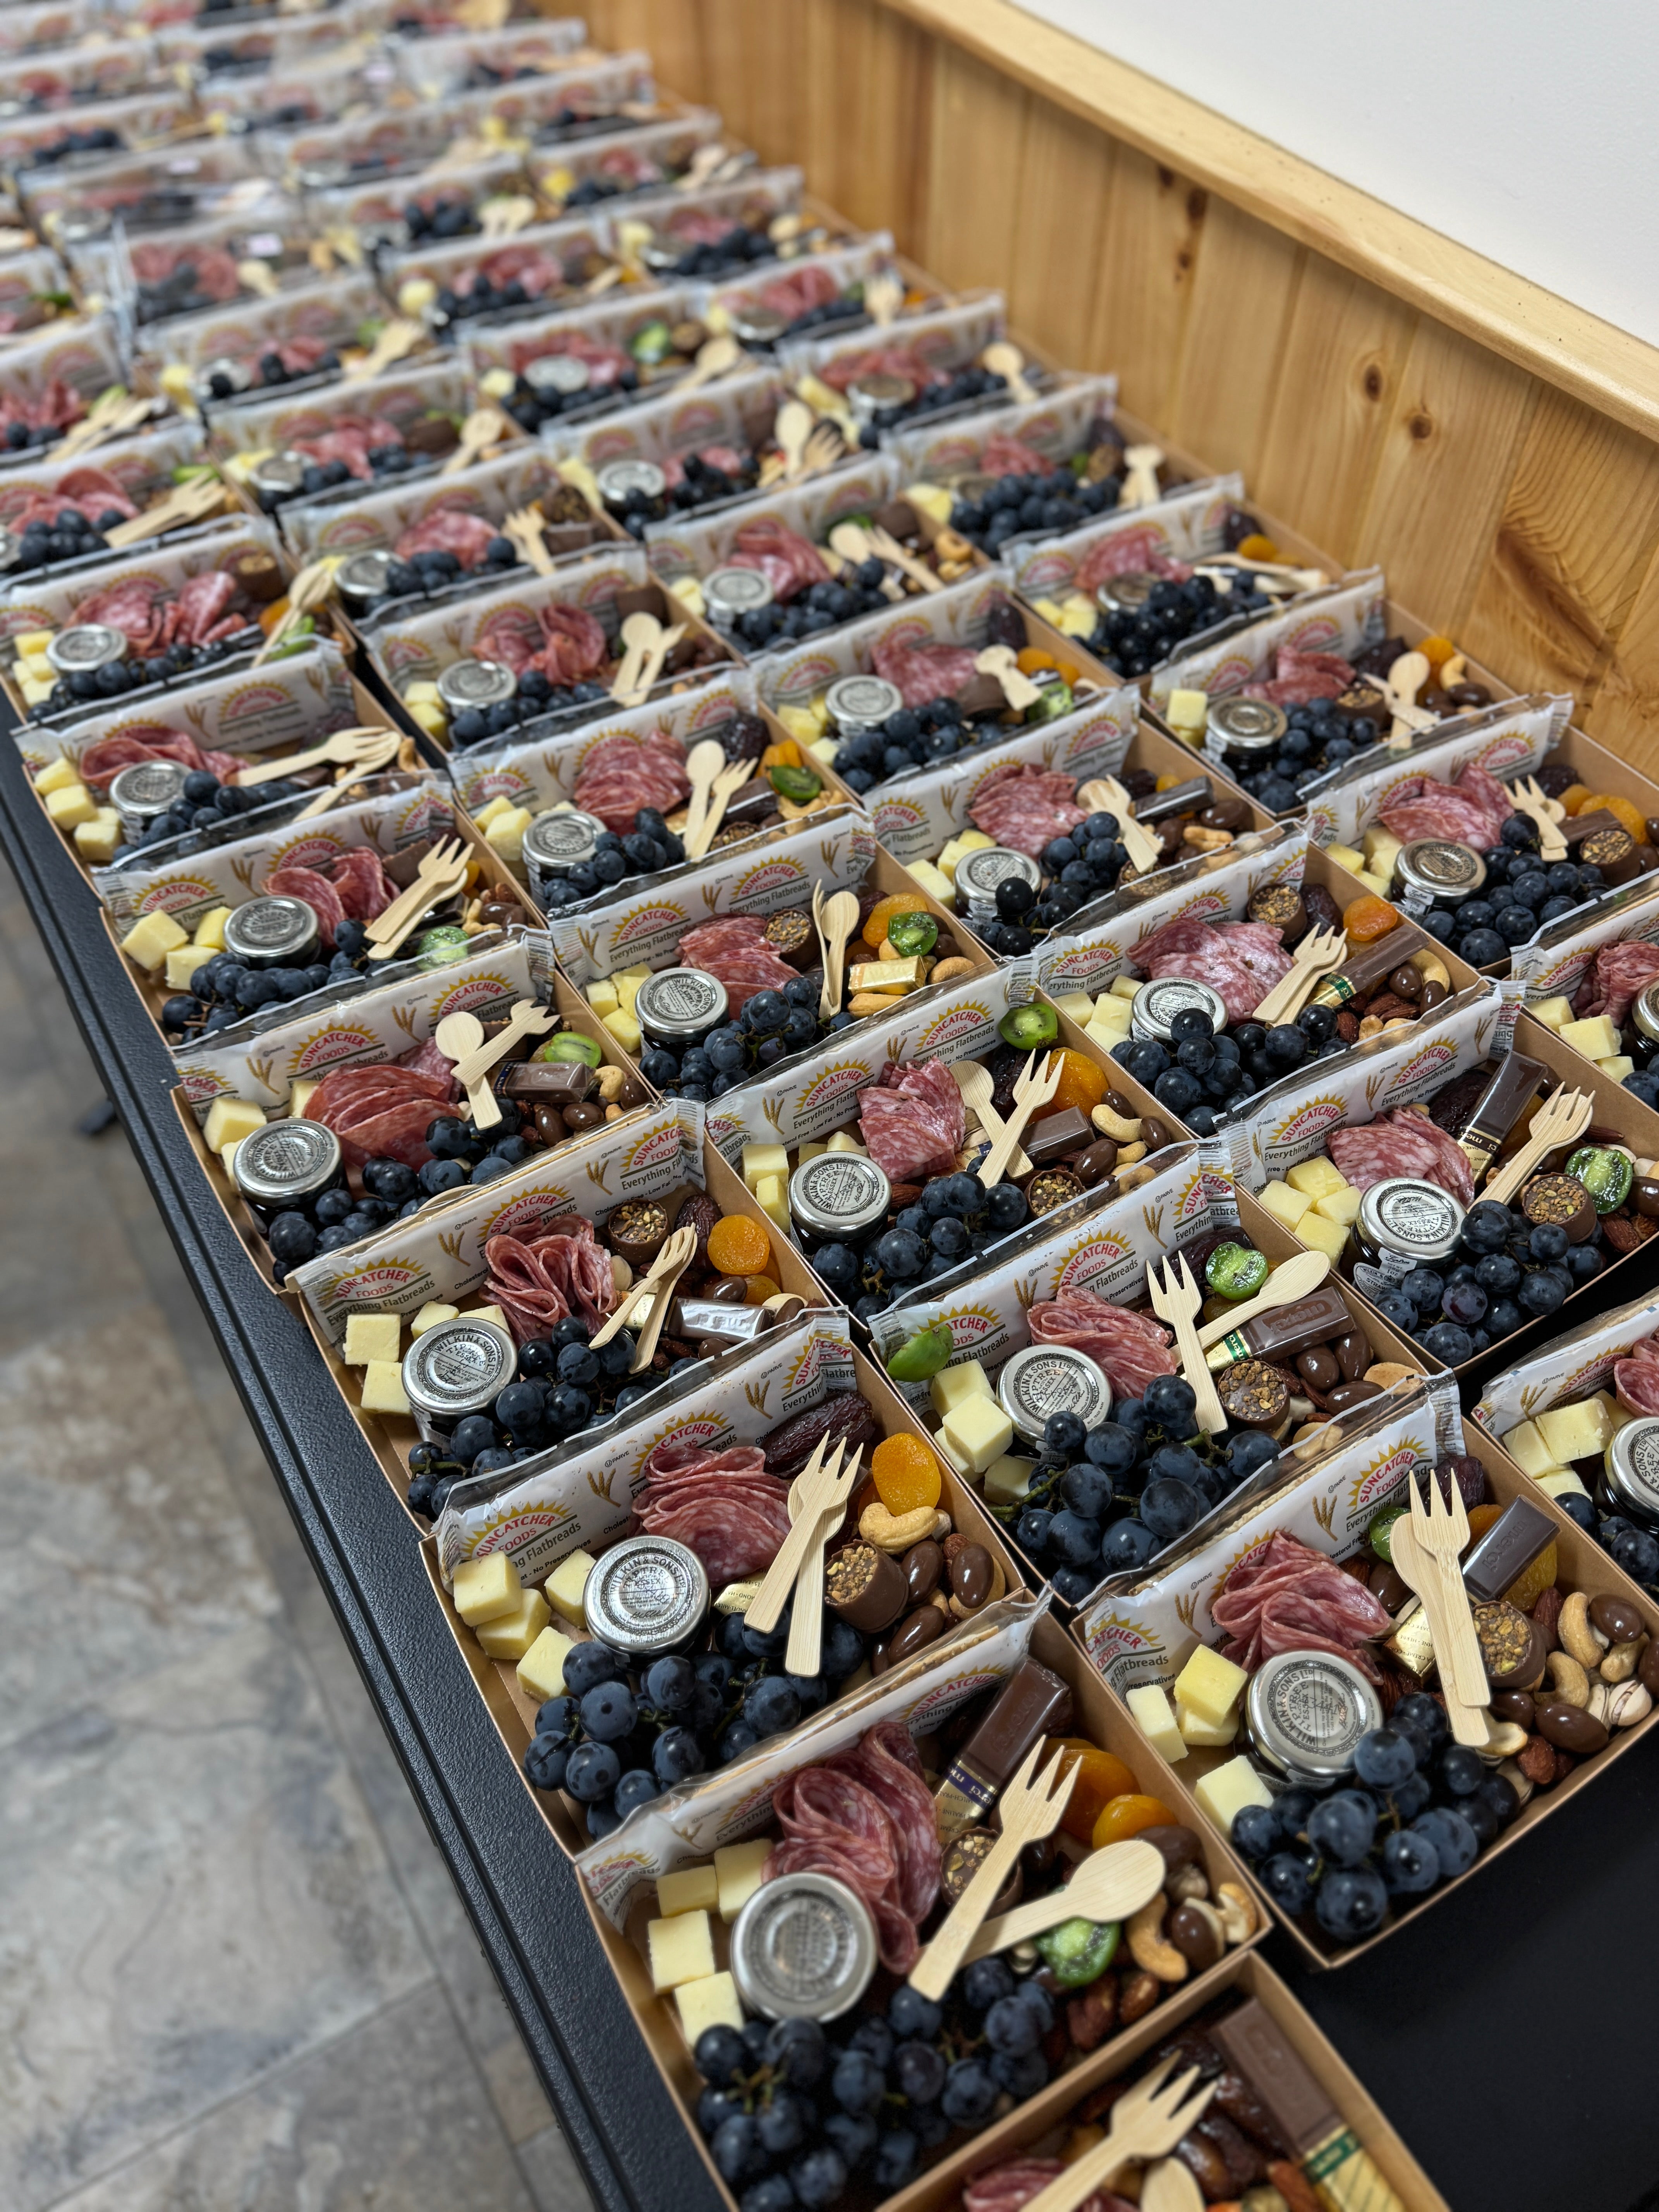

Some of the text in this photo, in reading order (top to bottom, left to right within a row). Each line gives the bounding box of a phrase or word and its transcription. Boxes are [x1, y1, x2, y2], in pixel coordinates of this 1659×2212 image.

[741, 865, 798, 895] SUNCATCHER
[755, 878, 783, 891] FOODS
[771, 882, 811, 902] Flatbreads
[621, 910, 678, 941] SUNCATCHER
[635, 922, 663, 937] FOODS
[610, 941, 651, 963] Everything
[1056, 949, 1112, 975] SUNCATCHER
[1049, 981, 1085, 990] erything
[1087, 962, 1121, 986] Flatbreads
[1072, 962, 1099, 975] FOODS
[441, 982, 501, 1016] SUNCATCHER
[458, 994, 488, 1012] FOODS
[674, 978, 704, 990] WILKIN
[700, 994, 711, 1011] SONS
[926, 1011, 983, 1046] SUNCATCHER
[941, 1024, 968, 1041] FOODS
[301, 1032, 366, 1068] SUNCATCHER
[316, 1045, 350, 1063] FOODS
[919, 1025, 994, 1066] verything Flatbreads
[963, 1039, 996, 1058] Preservatives
[1398, 1048, 1452, 1084] SUNCATCHER
[1412, 1062, 1437, 1080] FOODS
[807, 1071, 861, 1107] SUNCATCHER
[822, 1083, 848, 1102] FOODS
[1382, 1084, 1423, 1106] Everything
[1422, 1061, 1455, 1087] Flatbreads
[793, 1103, 834, 1130] Everything
[798, 1130, 810, 1140] Free
[813, 1123, 823, 1132] Low
[824, 1117, 833, 1125] Fat
[1281, 1106, 1339, 1142] SUNCATCHER
[1298, 1120, 1325, 1138] FOODS
[255, 1143, 268, 1162] SONS
[720, 1135, 751, 1158] atbreads
[1265, 1142, 1309, 1161] Everything
[1310, 1119, 1346, 1146] Flatbreads
[621, 1166, 671, 1191] Everything
[814, 1165, 835, 1180] SONS
[648, 1187, 661, 1195] Low
[810, 1185, 832, 1210] WILKIN
[1161, 1188, 1174, 1200] PARVE
[491, 1195, 556, 1234] SUNCATCHER
[508, 1207, 541, 1227] FOODS
[1400, 1217, 1439, 1233] TIPTREE
[1433, 1213, 1449, 1239] WILKIN
[1175, 1216, 1212, 1242] Everythin
[1396, 1227, 1422, 1240] SONS
[1034, 1262, 1049, 1272] PARVE
[1062, 1244, 1120, 1286] SUNCATCHER
[1077, 1259, 1106, 1281] FOODS
[1096, 1260, 1138, 1292] Flatbreads
[335, 1269, 410, 1298] SUNCATCHER
[356, 1283, 394, 1298] FOODS
[454, 1267, 488, 1290] Cholesterol
[1108, 1276, 1144, 1299] Preservatives
[383, 1279, 435, 1307] Flatbreads
[945, 1317, 988, 1334] ATCHER
[434, 1335, 474, 1352] WILKIN
[481, 1340, 496, 1362] SONS
[962, 1333, 1009, 1361] Flatbreads
[767, 1363, 783, 1375] PARVE
[984, 1350, 1018, 1373] reservatives
[783, 1381, 823, 1412] Everythin
[1022, 1379, 1040, 1413] WILKIN
[1031, 1362, 1057, 1374] SONS
[1040, 1377, 1056, 1396] ESSEX
[612, 1450, 629, 1463] PARVE
[644, 1424, 716, 1470] NCATCHER
[1640, 1439, 1649, 1452] LTD
[1637, 1451, 1650, 1477] SONS
[1333, 1475, 1346, 1490] PARVE
[1360, 1451, 1415, 1503] SUNCATCHER
[1376, 1468, 1404, 1496] FOODS
[603, 1515, 631, 1534] Cholest
[1346, 1497, 1392, 1533] Everything
[477, 1515, 555, 1558] SUNCATCHER
[499, 1528, 536, 1552] FOODS
[527, 1522, 582, 1561] Flatbreads
[1482, 1519, 1527, 1573] merci
[534, 1565, 544, 1574] No
[544, 1539, 591, 1568] Preservatives
[610, 1558, 641, 1592] WILKIN
[654, 1556, 679, 1574] SONS
[1197, 1571, 1213, 1586] PARVE
[1087, 1626, 1142, 1655] CATCHER
[1096, 1643, 1121, 1670] OODS
[1114, 1655, 1169, 1681] Flatbreads
[1128, 1674, 1175, 1690] reservatives
[1278, 1673, 1300, 1698] SONS
[1300, 1669, 1313, 1680] LTD
[1278, 1709, 1316, 1746] WILKIN
[970, 1785, 992, 1805] erci
